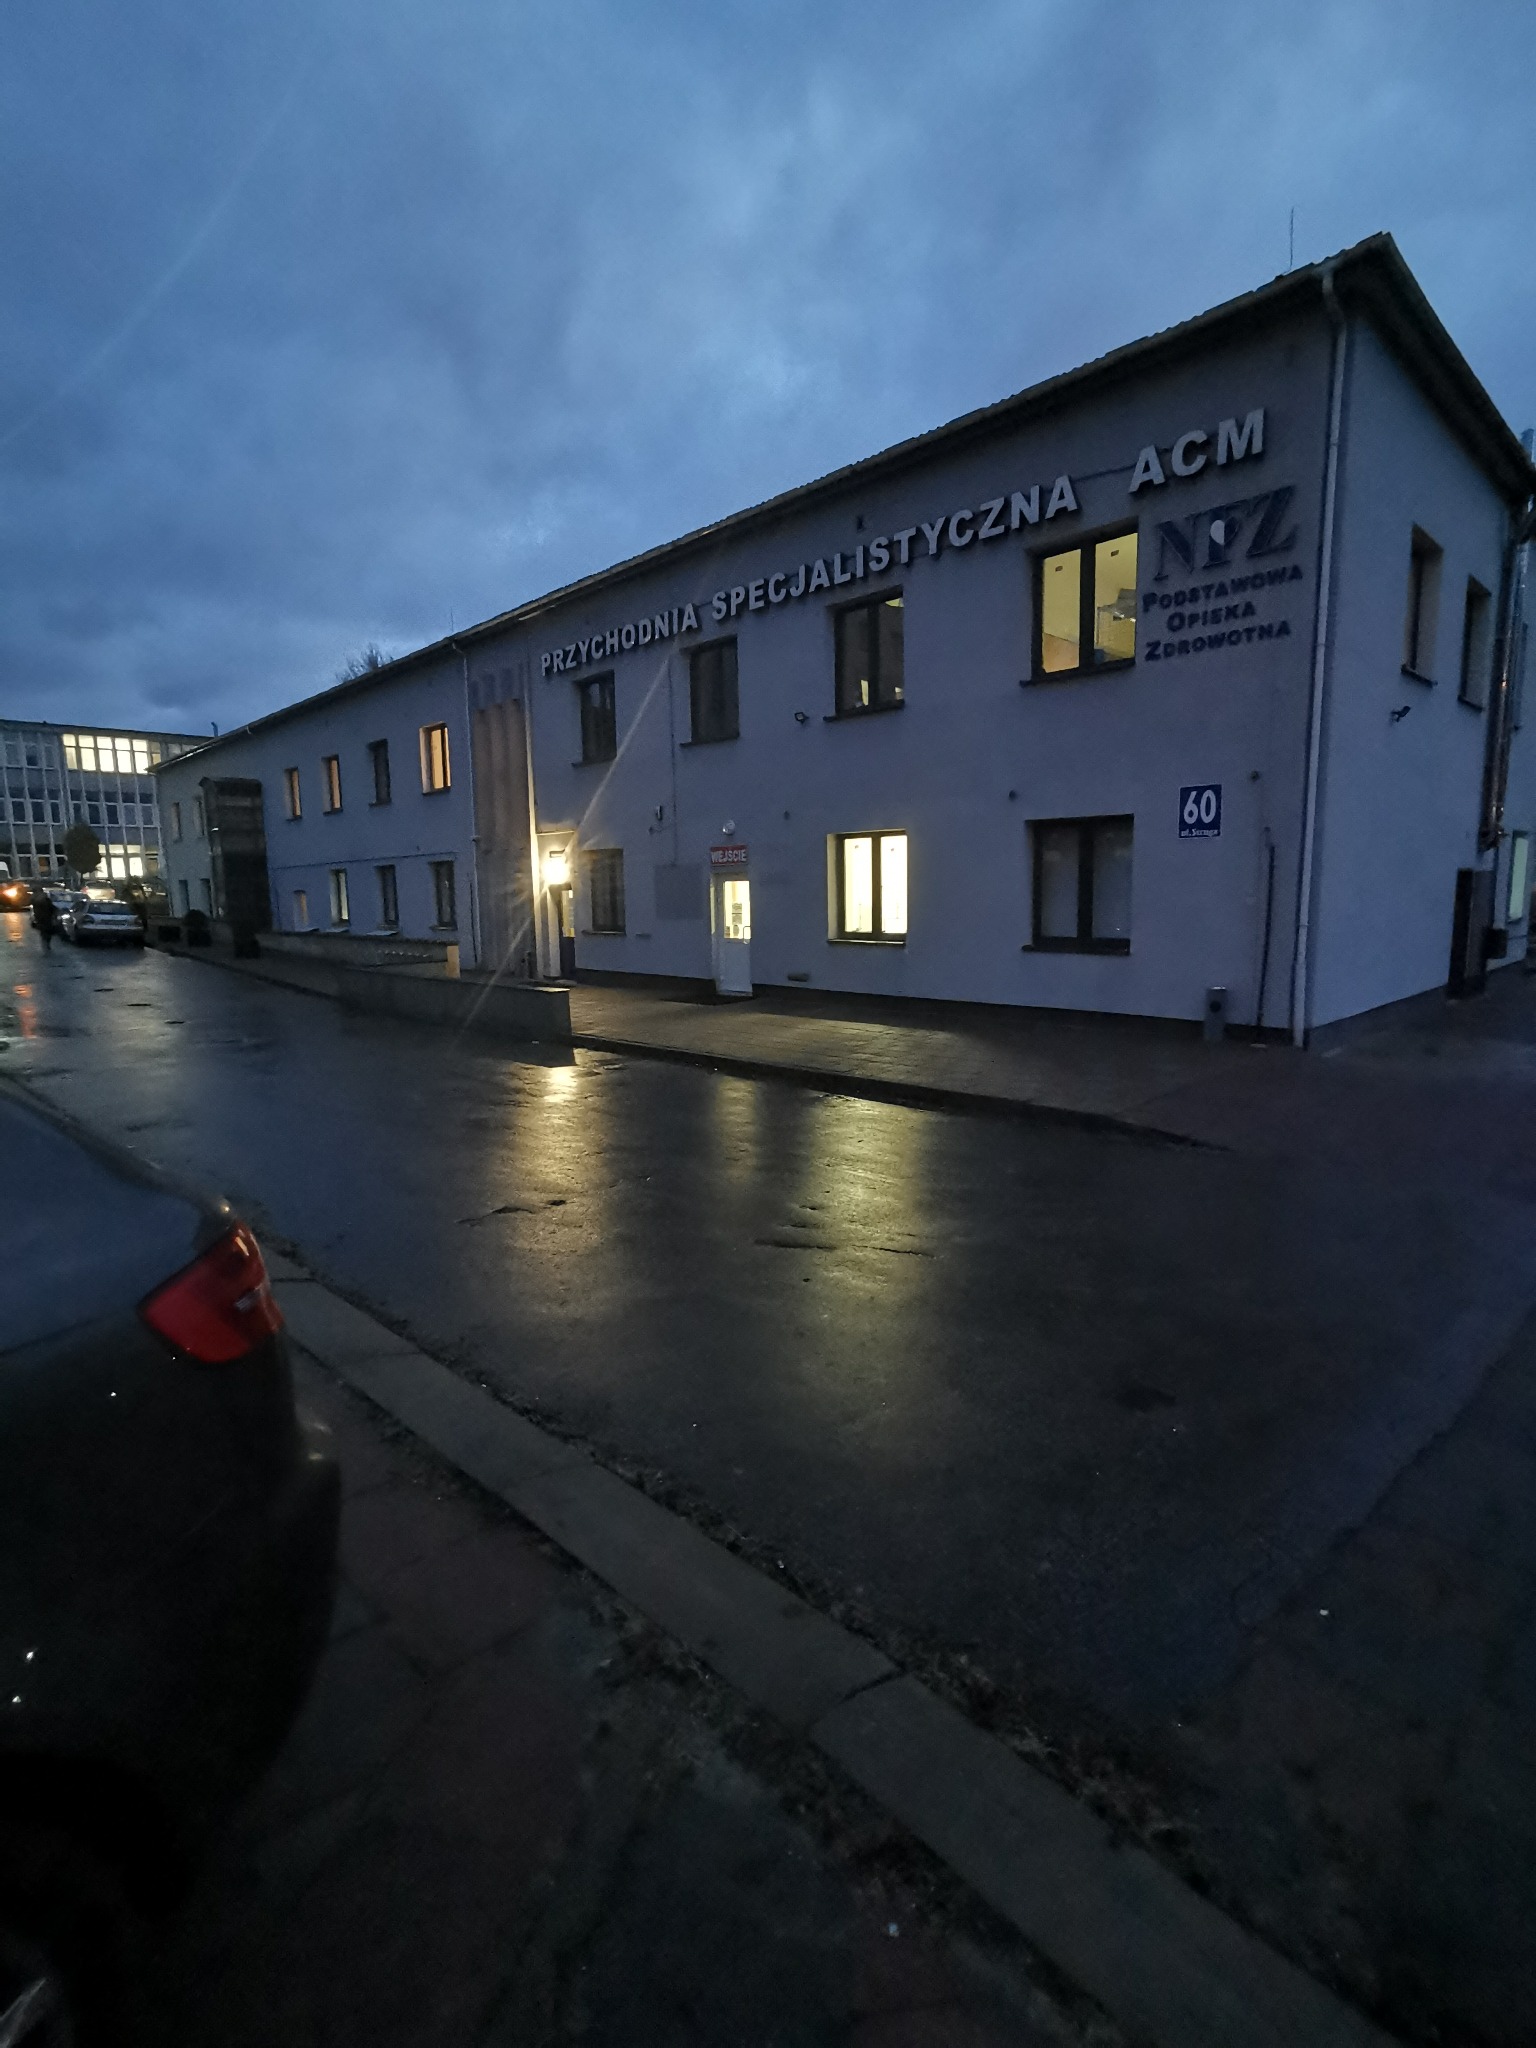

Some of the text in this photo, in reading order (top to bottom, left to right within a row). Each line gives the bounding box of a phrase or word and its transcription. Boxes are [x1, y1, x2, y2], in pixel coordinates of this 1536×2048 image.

[540, 408, 1265, 676] PRZYCHODNIA SPECJALISTYCZNA ACM
[1183, 789, 1217, 824] 60
